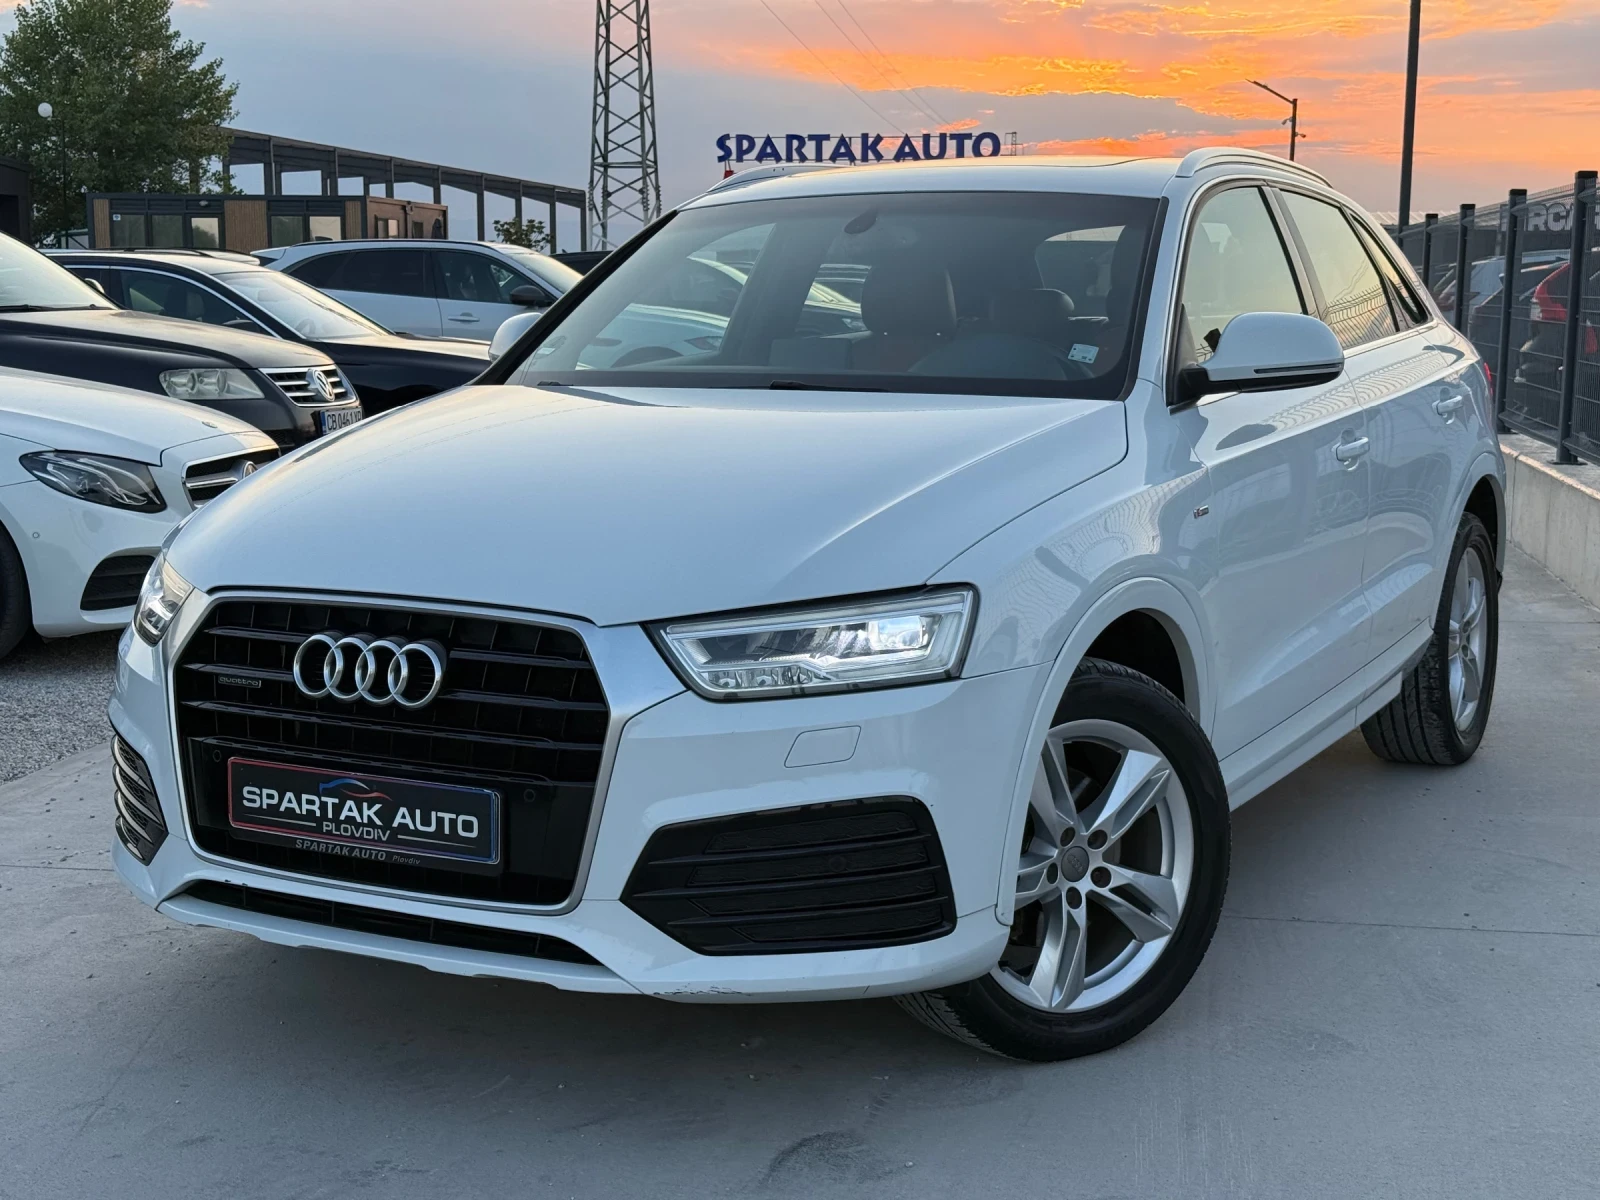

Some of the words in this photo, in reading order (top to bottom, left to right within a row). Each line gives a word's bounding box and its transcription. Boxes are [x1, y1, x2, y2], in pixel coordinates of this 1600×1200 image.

[716, 133, 884, 163] SPARTAK
[893, 132, 1001, 162] AUTO
[219, 676, 259, 686] quattro
[242, 786, 383, 826] SPARTAK
[392, 807, 479, 838] AUTO
[322, 821, 390, 841] PLOVDIV
[295, 839, 350, 856] SPARTAK
[352, 847, 386, 861] AUTO
[392, 855, 421, 865] Plovdiv
